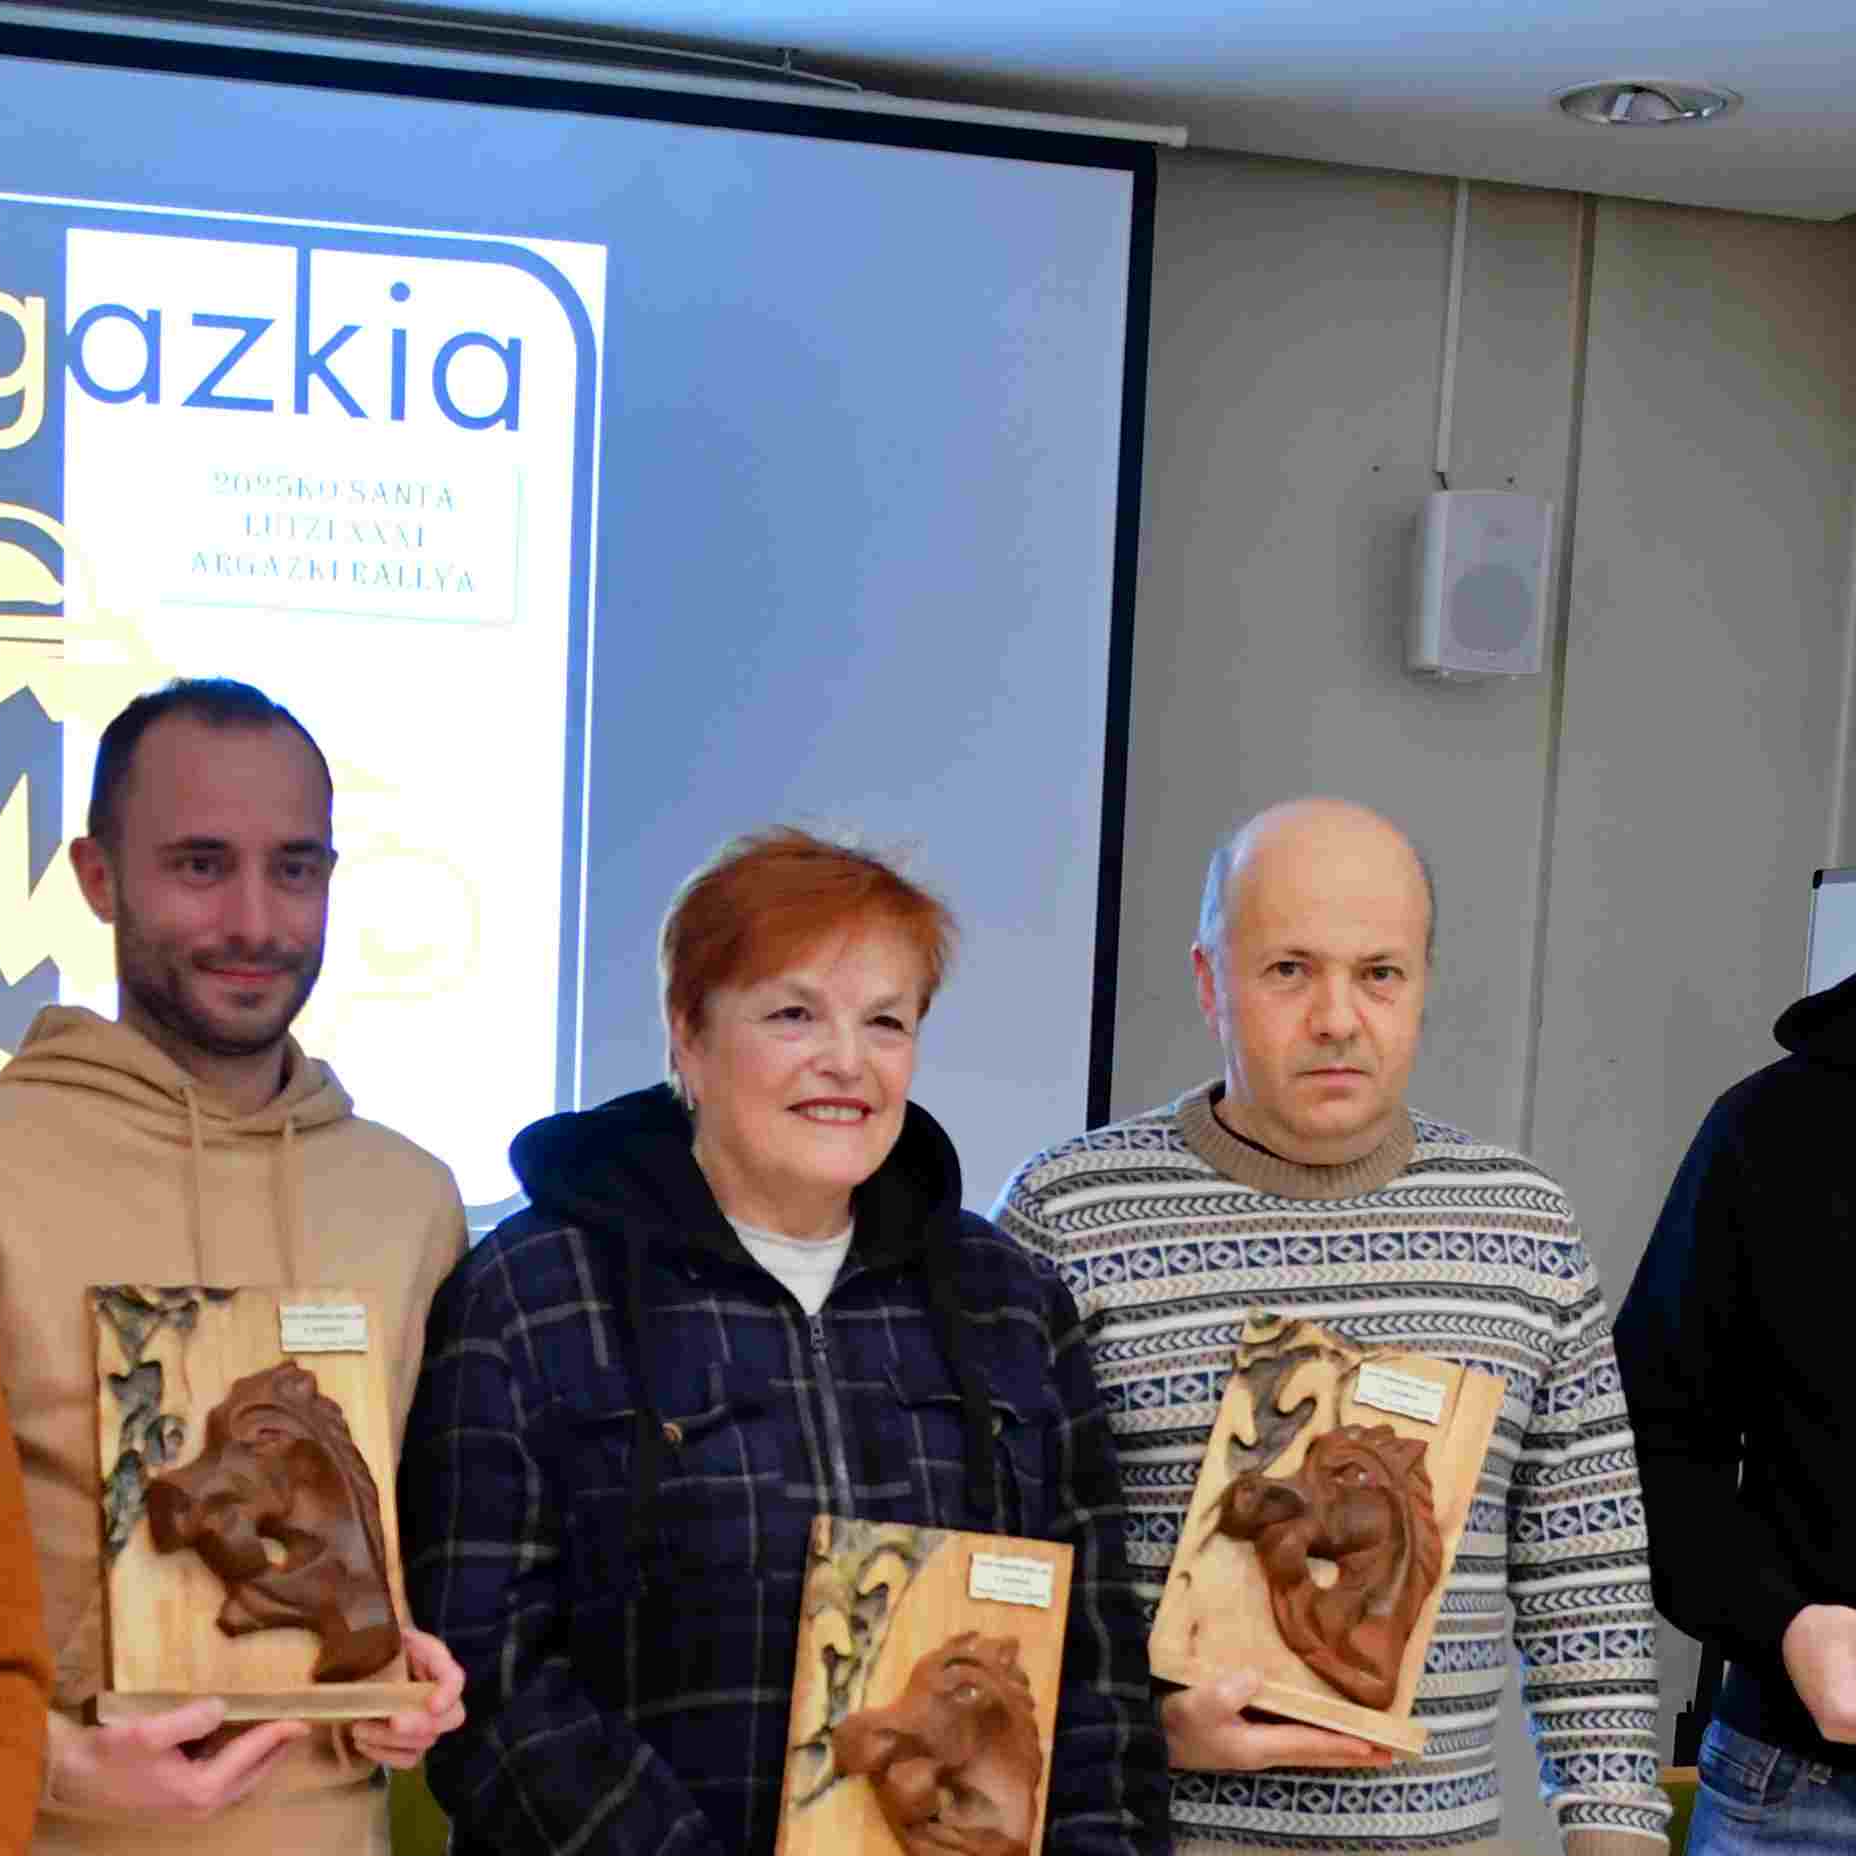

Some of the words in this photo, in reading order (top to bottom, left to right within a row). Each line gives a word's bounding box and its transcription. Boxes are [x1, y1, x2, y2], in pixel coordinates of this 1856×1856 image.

[351, 479, 455, 510] SANTA
[192, 551, 338, 583] ARGAZKI
[351, 560, 478, 594] RALLYA
